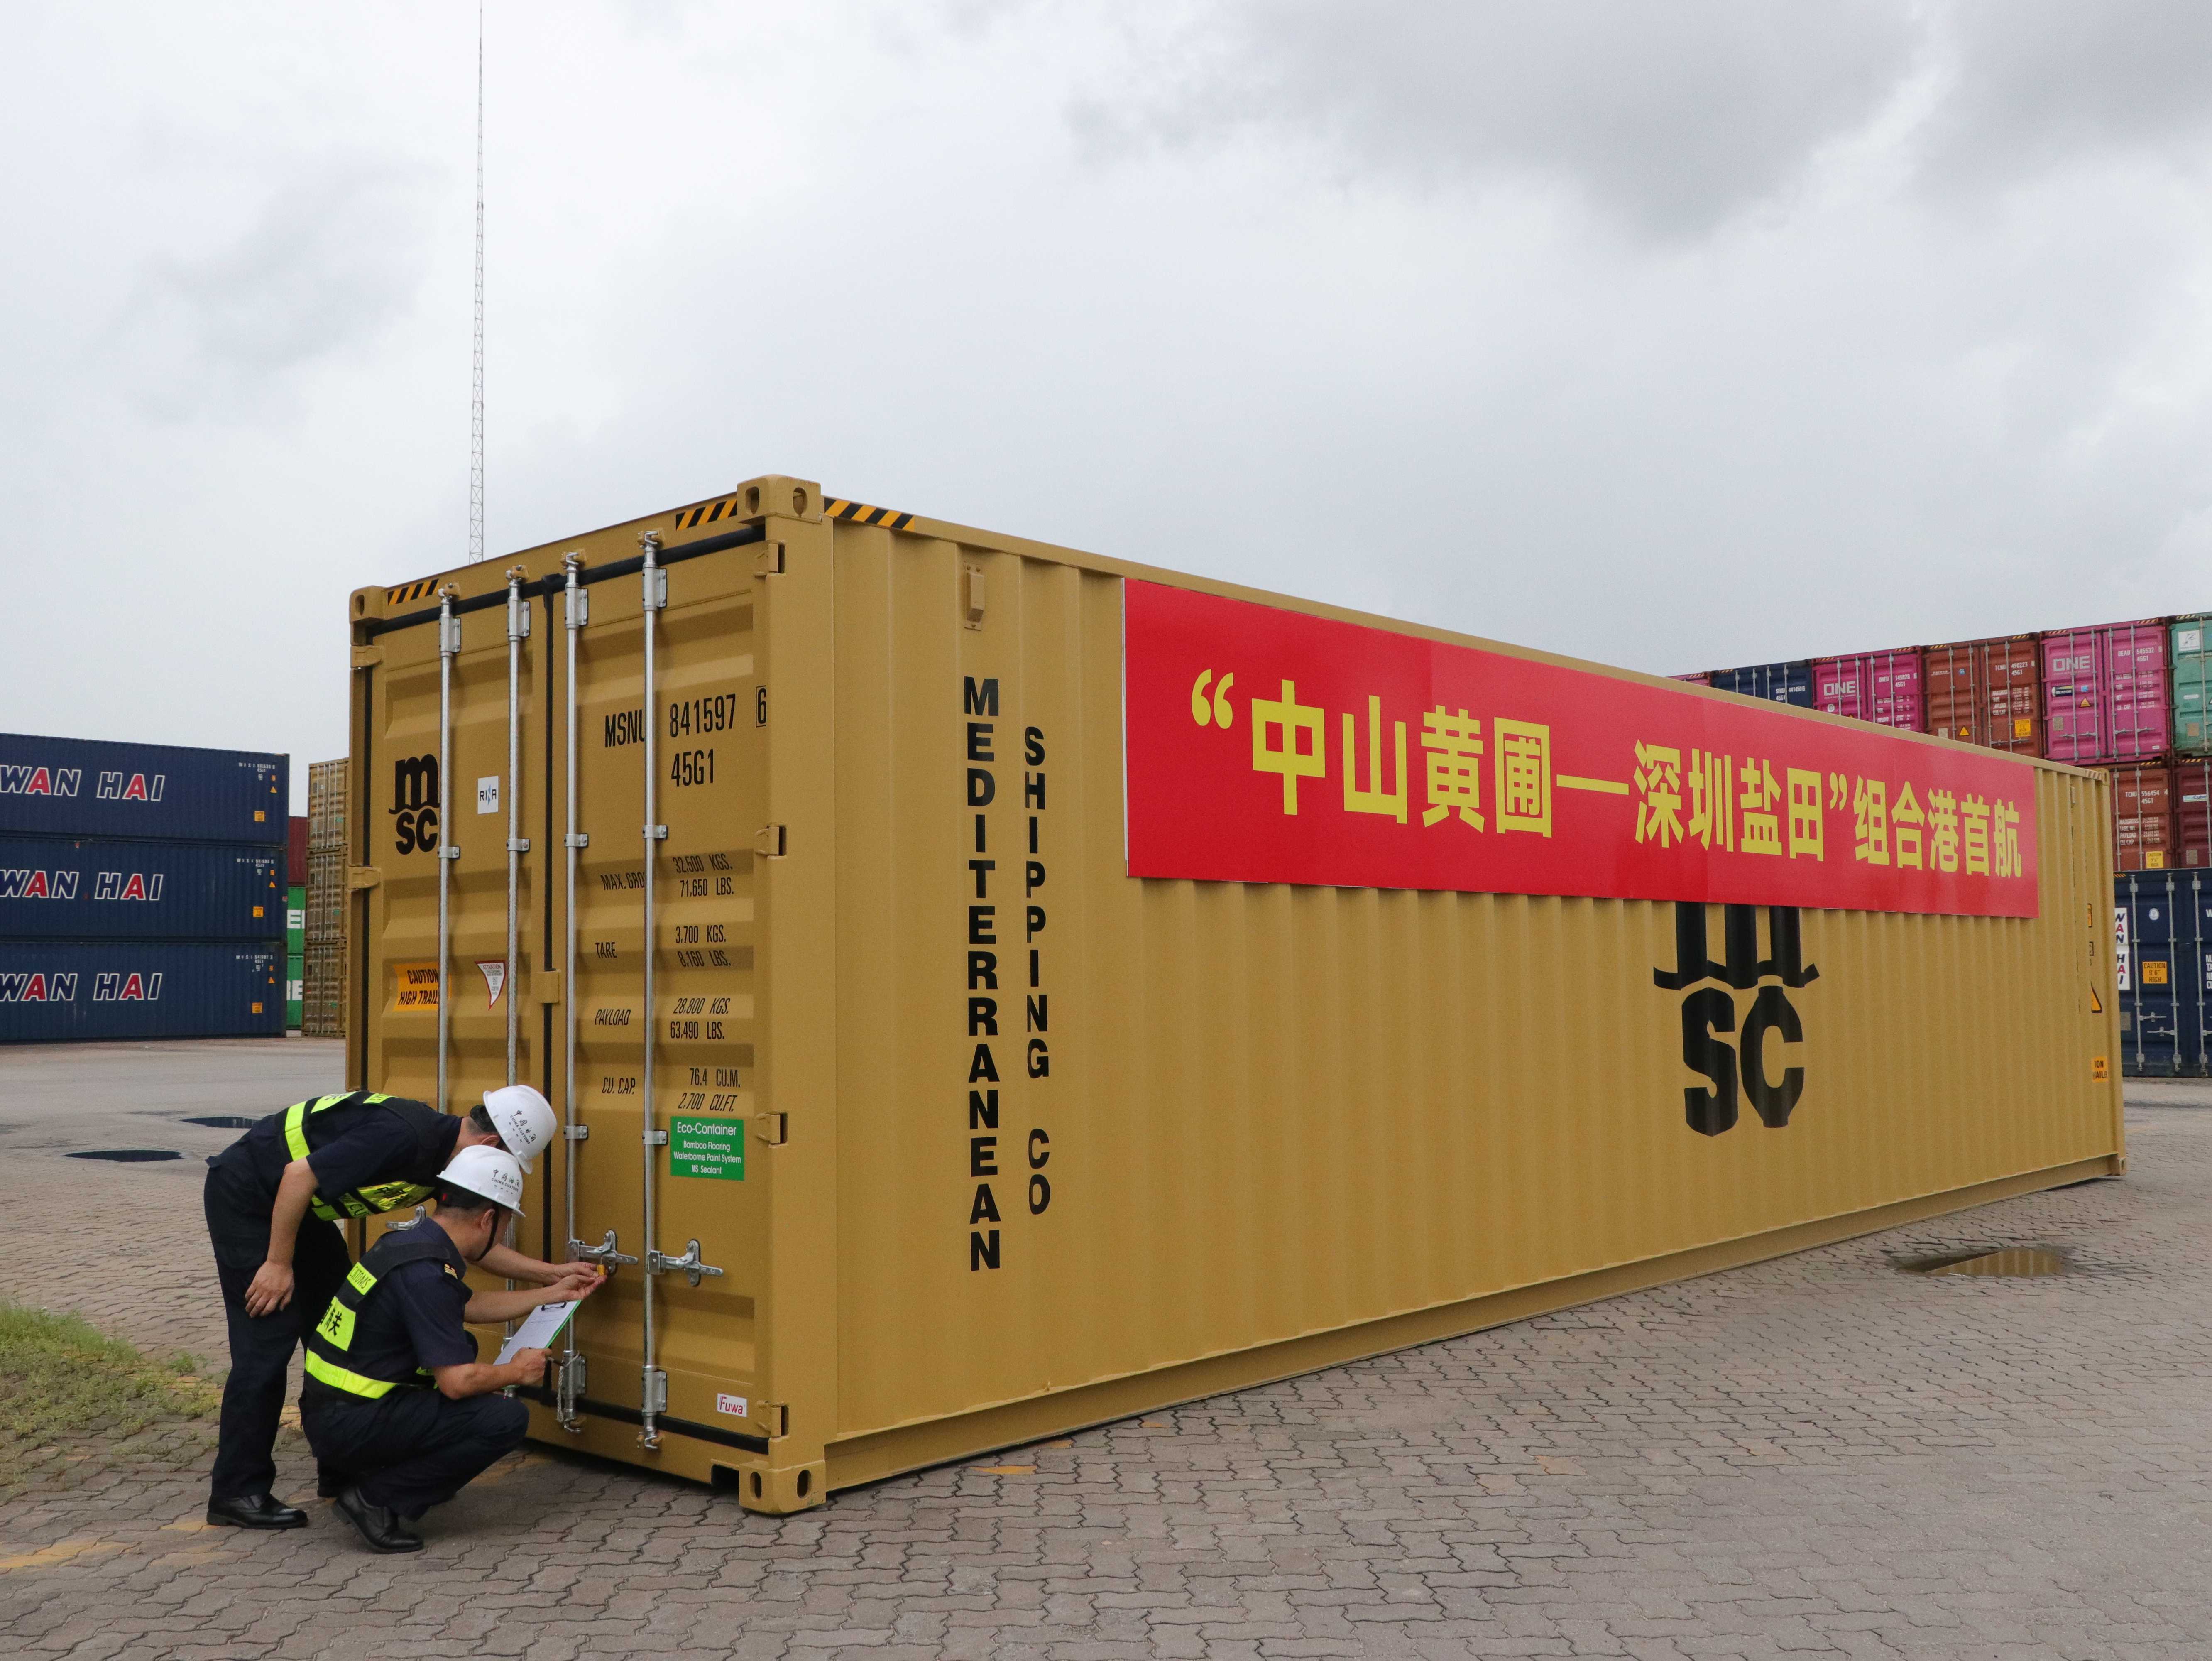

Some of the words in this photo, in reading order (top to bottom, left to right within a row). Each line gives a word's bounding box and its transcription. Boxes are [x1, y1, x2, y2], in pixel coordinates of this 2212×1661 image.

[2053, 656, 2090, 671] ONE
[1824, 681, 1855, 696] ONE
[670, 693, 736, 738] 841597
[758, 688, 766, 724] 6
[671, 749, 714, 787] 45G1
[0, 764, 81, 796] WAN
[96, 772, 165, 801] HAI
[601, 874, 626, 890] MAX.
[625, 872, 644, 889] GRO
[673, 855, 705, 873] 32,500
[709, 853, 733, 871] KGS.
[0, 870, 79, 899] WAN
[94, 872, 164, 901] HAI
[680, 878, 708, 897] 71,650
[716, 877, 734, 895] LBS.
[1024, 725, 1050, 1079] SHIPPING
[595, 942, 617, 959] TARE
[675, 925, 698, 944] 3,700
[707, 924, 726, 943] KGS.
[709, 950, 732, 967] LBS.
[2117, 954, 2126, 984] HAI
[407, 969, 438, 984] CAUTION
[964, 676, 1001, 1271] MEDITERRANEAN
[0, 973, 78, 1002] WAN
[93, 973, 162, 1001] HAI
[398, 991, 417, 1005] HIGH
[418, 990, 438, 1004] TRAIL
[595, 1009, 631, 1026] PAYLOAD
[710, 997, 730, 1014] KGS.
[670, 1021, 699, 1039] 63,490
[707, 1021, 725, 1039] LBS.
[618, 1077, 636, 1095] CAP.
[690, 1068, 707, 1086] 76.4
[716, 1068, 740, 1088] CU.M.
[678, 1093, 705, 1110] 2,700
[710, 1094, 738, 1112] CU.FT.
[677, 1122, 737, 1136] Eco-Container
[673, 1151, 706, 1161] Waterborne
[707, 1153, 720, 1162] Paint
[722, 1154, 741, 1164] System
[683, 1140, 707, 1149] Bamboo
[708, 1142, 731, 1152] Flooring
[700, 1165, 722, 1174] Sealant
[1028, 1128, 1050, 1215] CO
[719, 1396, 744, 1415] Fuwa
